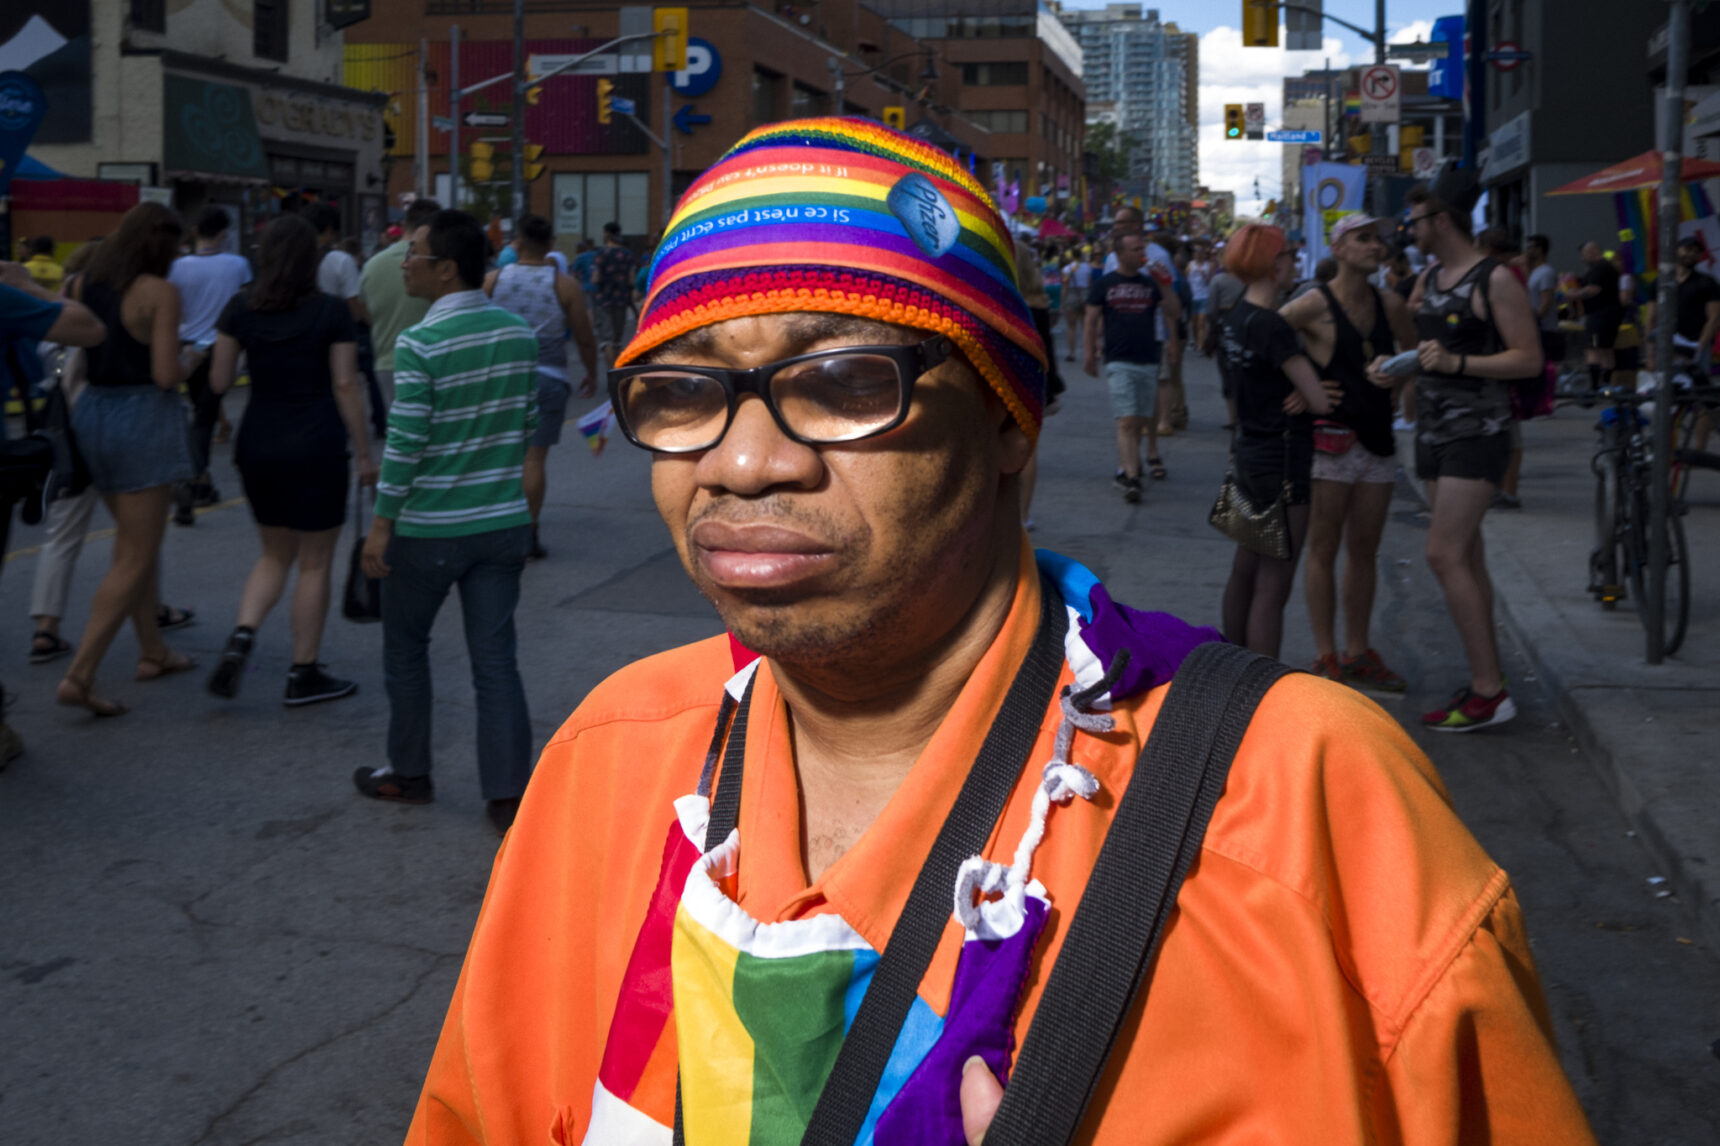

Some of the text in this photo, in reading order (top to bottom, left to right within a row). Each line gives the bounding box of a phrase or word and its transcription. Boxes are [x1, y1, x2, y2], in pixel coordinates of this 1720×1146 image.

[674, 46, 713, 87] P
[820, 165, 831, 176] it
[836, 167, 848, 178] If
[681, 207, 850, 242] Si ce n'est pas écrit
[901, 183, 946, 250] Pfizer
